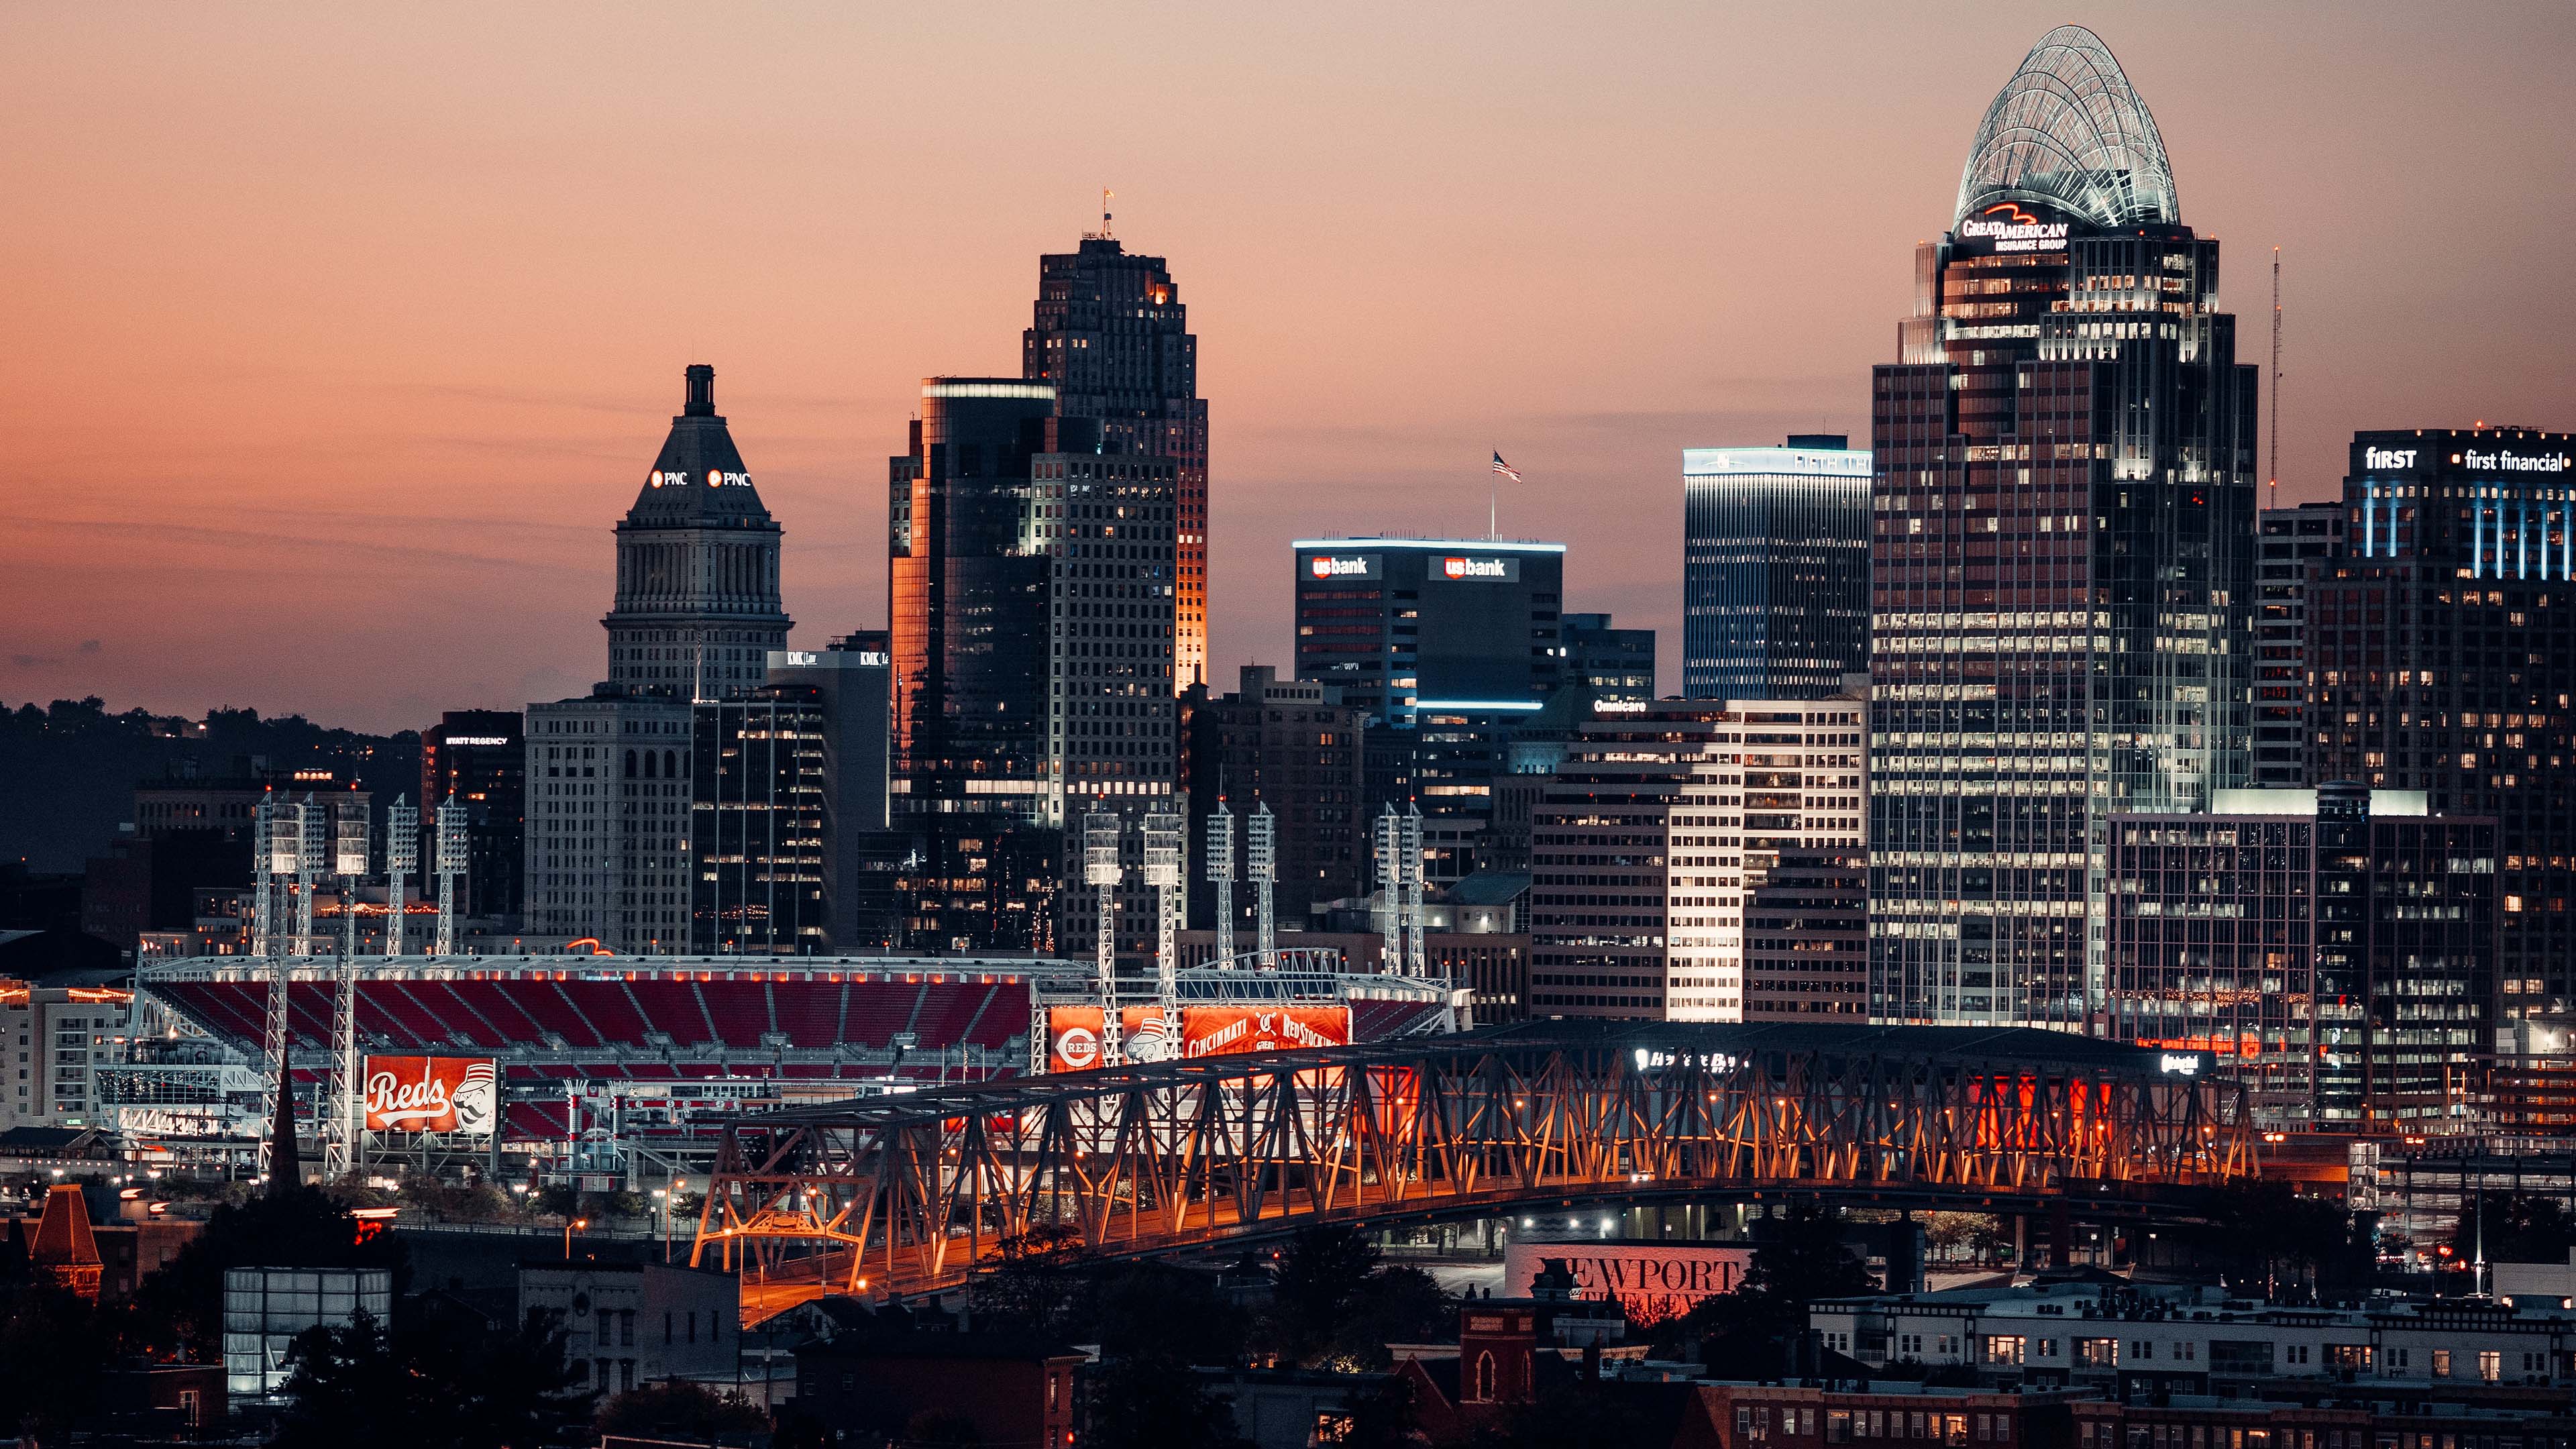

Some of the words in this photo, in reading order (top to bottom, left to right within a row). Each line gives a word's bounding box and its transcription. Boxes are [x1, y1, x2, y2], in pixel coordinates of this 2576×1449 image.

[1996, 240, 2037, 252] INSURANCE
[2039, 239, 2067, 250] GROUP
[1794, 454, 1837, 470] FIFTH
[1846, 457, 1872, 470] THI
[2465, 449, 2496, 470] first
[2500, 449, 2563, 472] financial
[664, 472, 687, 486] PNC
[723, 472, 751, 486] PNC
[788, 651, 804, 665] KMK
[860, 651, 879, 665] KMK
[1594, 700, 1646, 712] Omnicare
[1189, 1018, 1247, 1058] CINCINNATI
[1299, 1022, 1341, 1047] STOCKIN
[1067, 1042, 1097, 1053] REDS
[1256, 1040, 1275, 1051] GREAT
[367, 1065, 450, 1124] Reds
[1538, 1256, 1739, 1291] EWPORT
